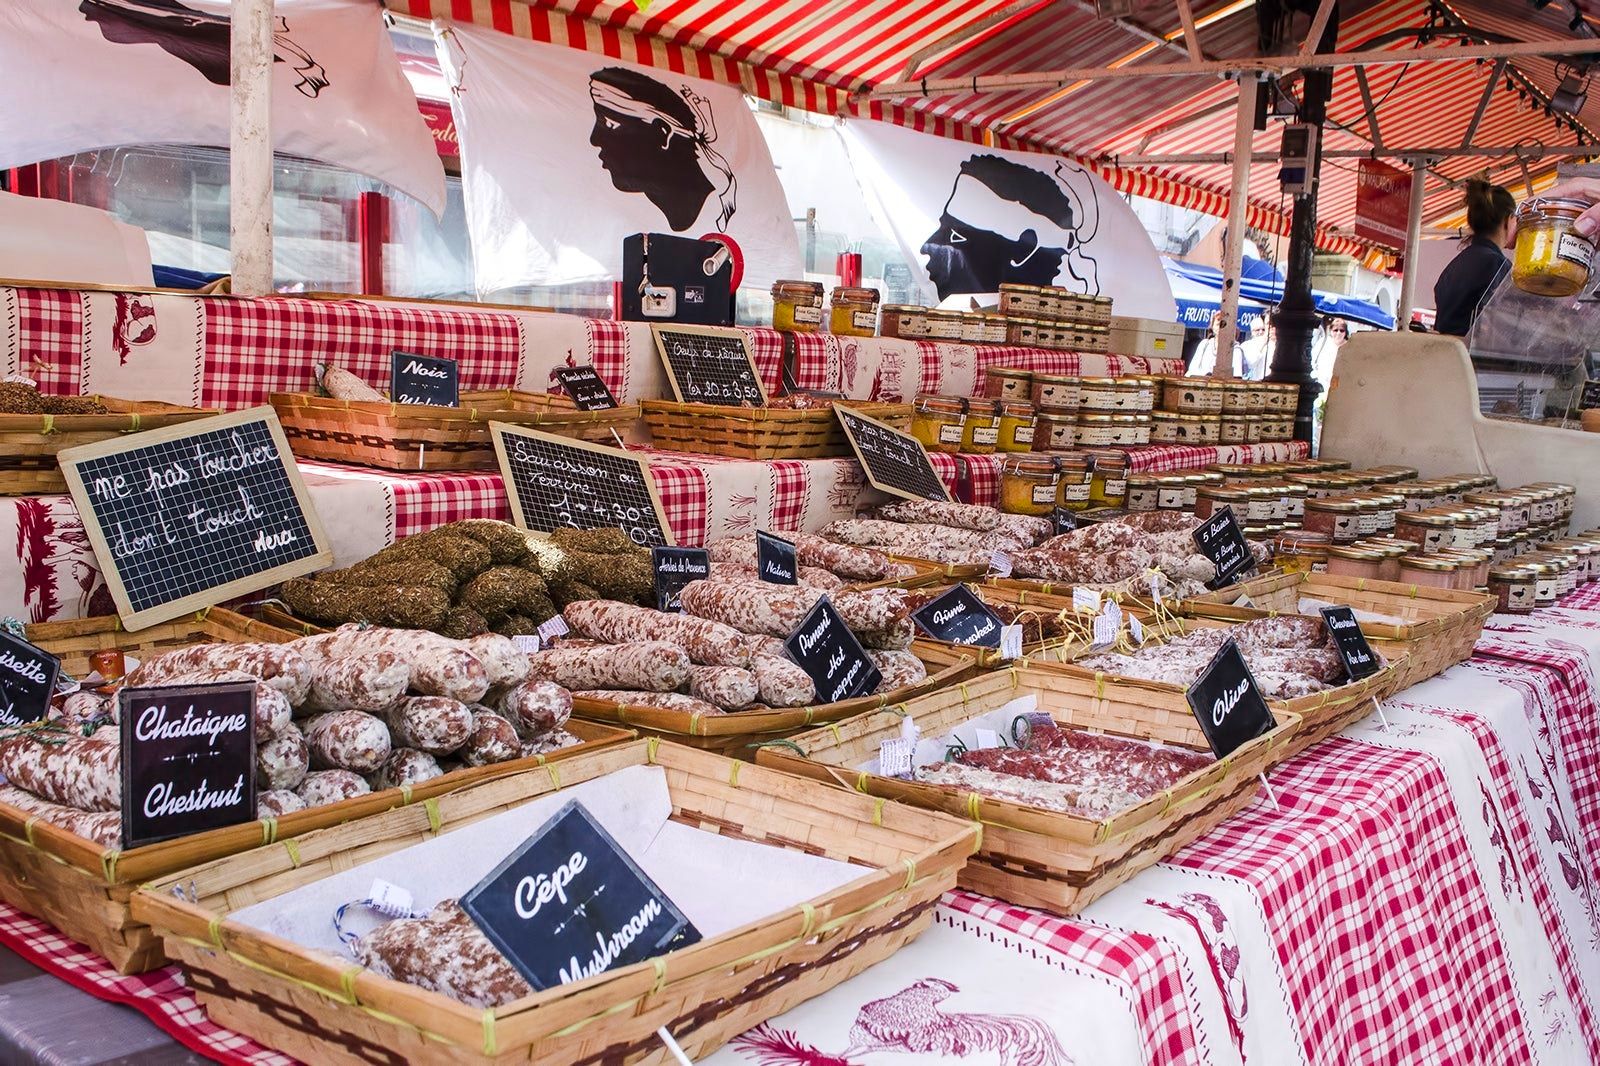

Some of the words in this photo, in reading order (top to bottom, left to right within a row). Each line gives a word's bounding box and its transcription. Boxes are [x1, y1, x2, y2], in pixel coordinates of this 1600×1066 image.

[1562, 237, 1577, 247] Foie
[1184, 305, 1211, 323] FRUITS
[402, 360, 448, 379] Noix
[702, 341, 714, 358] de
[704, 381, 720, 397] 20
[144, 462, 191, 508] pas
[194, 431, 280, 482] toucher
[514, 441, 608, 478] Saucisson
[619, 474, 639, 483] ou
[115, 511, 176, 557] don't
[188, 485, 264, 535] touch
[1203, 531, 1209, 543] 5
[1210, 516, 1230, 538] Baies
[765, 560, 792, 579] Nature
[1215, 551, 1220, 562] 5
[798, 608, 832, 656] Piment
[827, 646, 845, 679] Hot
[831, 658, 862, 703] pepper
[1212, 678, 1249, 727] Olive
[135, 704, 247, 746] Chataigne
[143, 774, 244, 819] Chestnut
[514, 851, 588, 919] Cêpe
[558, 897, 663, 986] Mushroom
